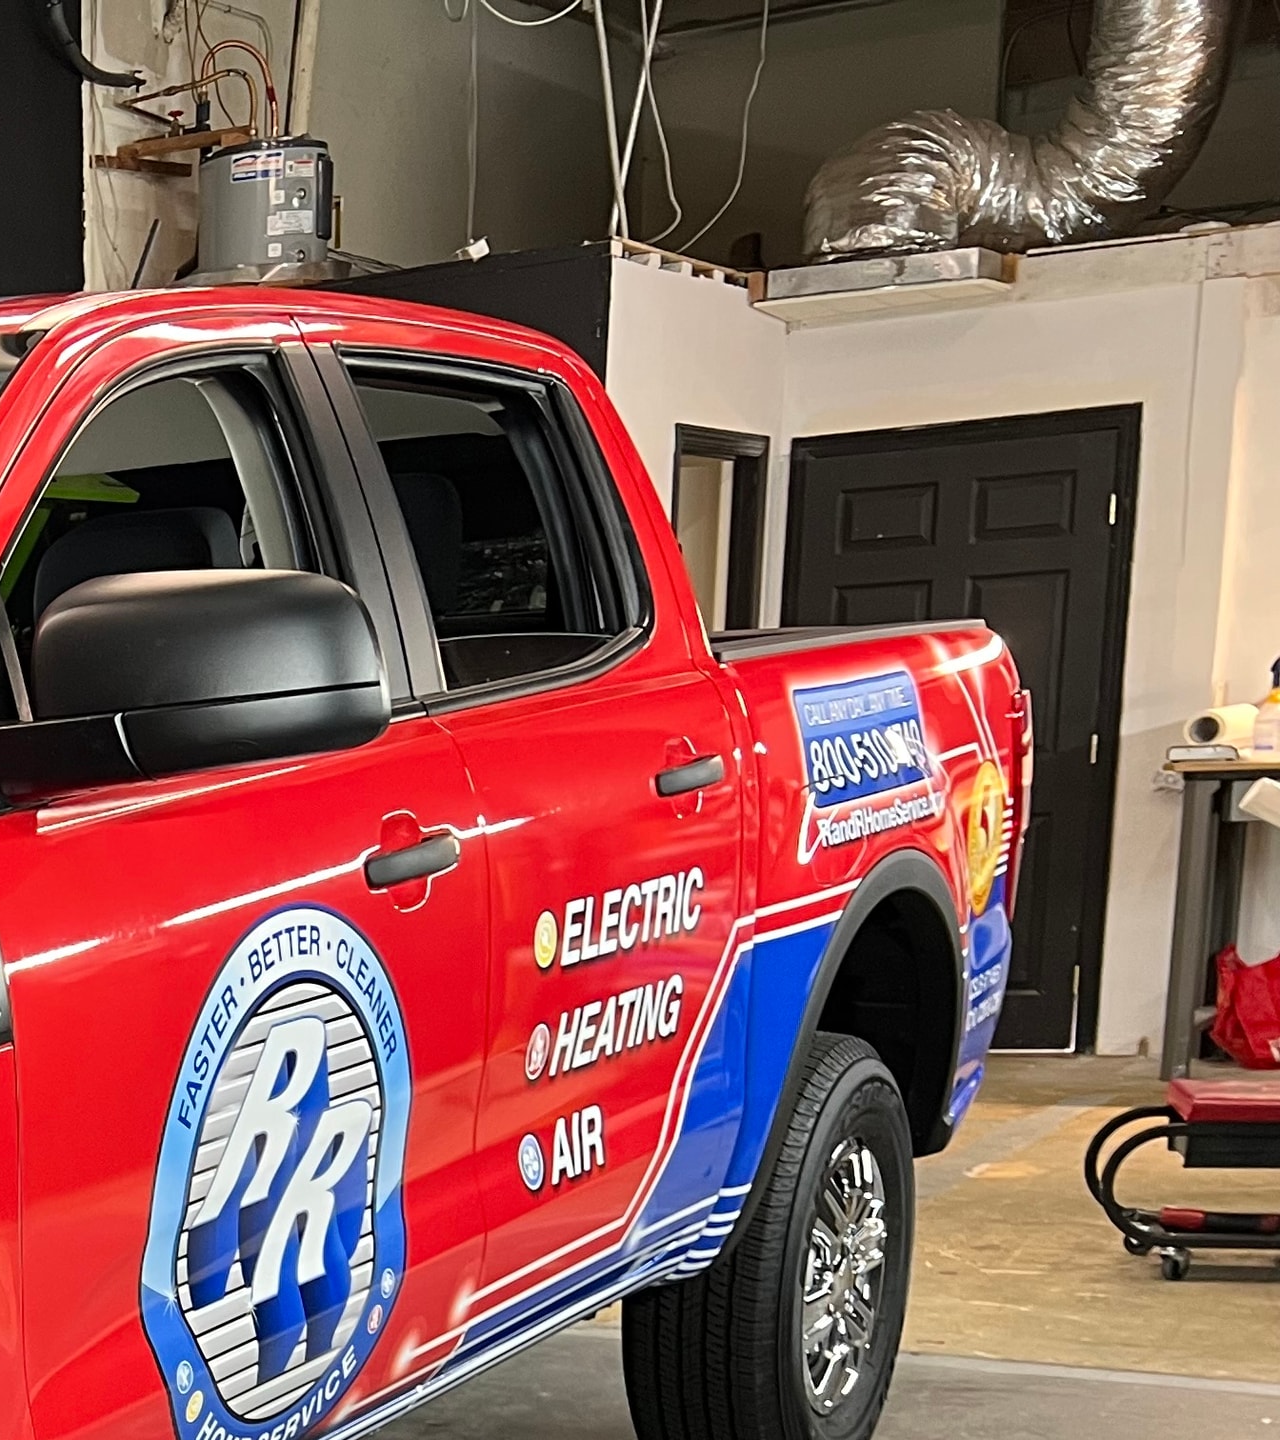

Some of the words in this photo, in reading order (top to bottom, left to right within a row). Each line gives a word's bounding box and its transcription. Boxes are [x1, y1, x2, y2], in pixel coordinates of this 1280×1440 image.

[560, 866, 704, 968] ELECTRIC
[177, 984, 239, 1130] FASTER
[247, 924, 321, 985] BETTER
[335, 938, 398, 1064] CLEANER
[548, 974, 684, 1078] HEATING
[551, 1105, 605, 1187] AIR
